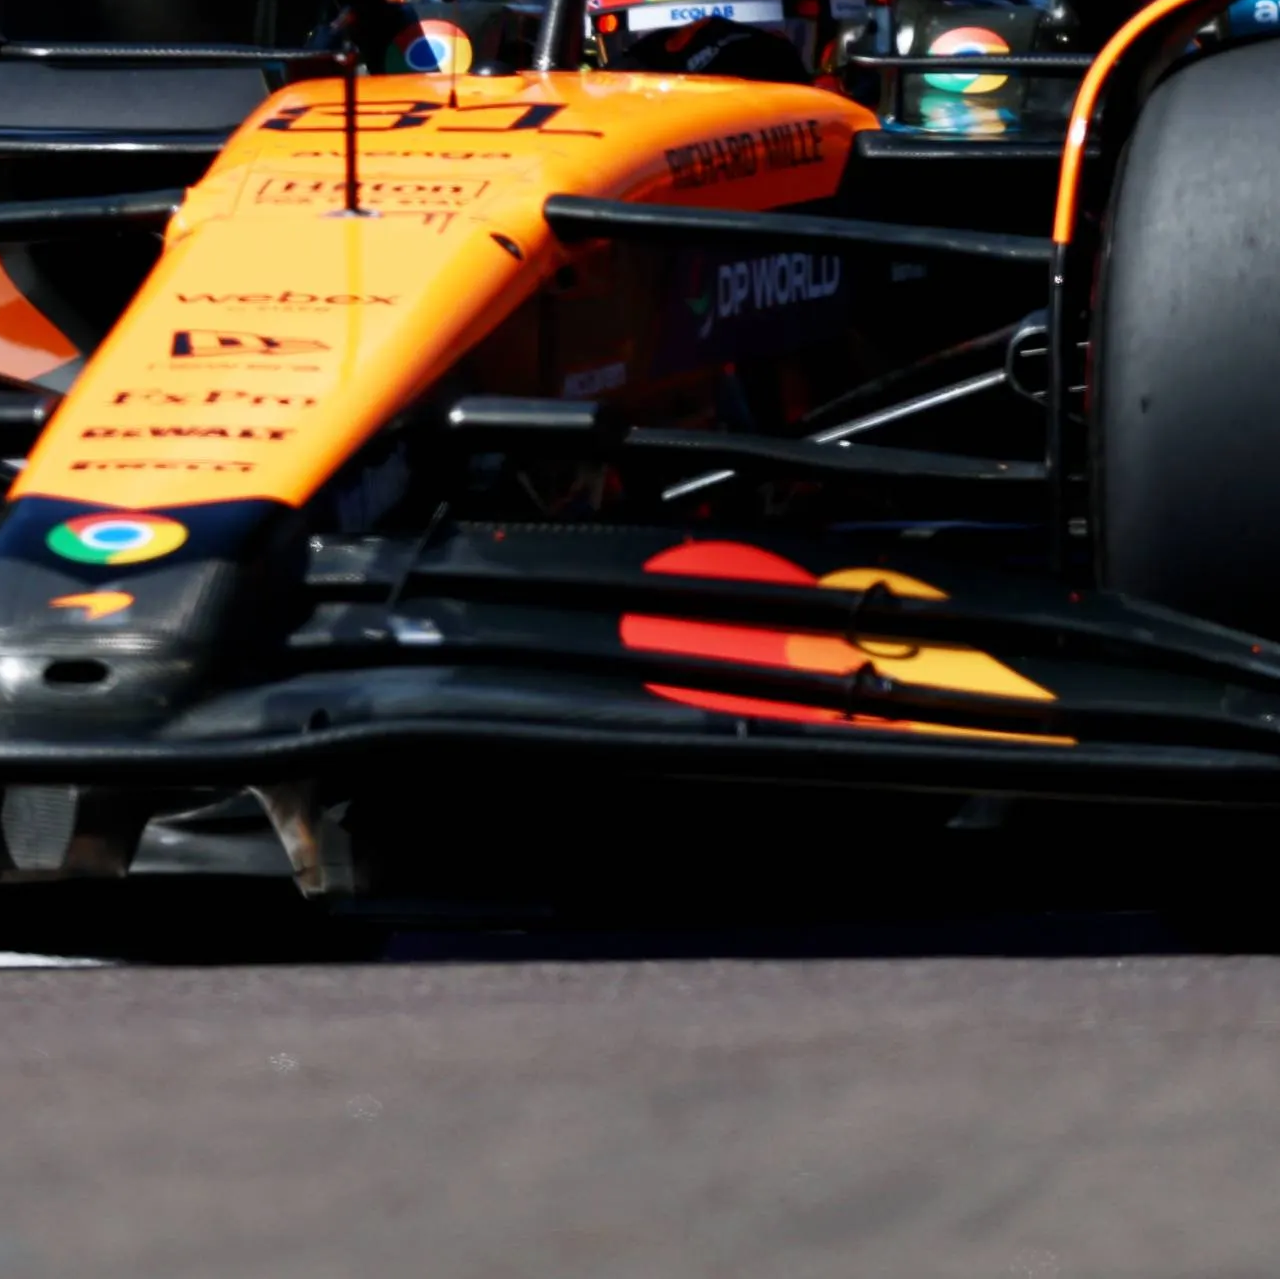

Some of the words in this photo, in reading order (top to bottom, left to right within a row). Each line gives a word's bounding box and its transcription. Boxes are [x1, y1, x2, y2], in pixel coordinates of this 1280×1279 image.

[670, 5, 735, 21] ECOLAB
[259, 99, 604, 139] 81
[663, 132, 757, 189] RICHARD
[759, 119, 824, 168] MILLE
[717, 260, 750, 318] DP
[750, 251, 841, 310] WORLD
